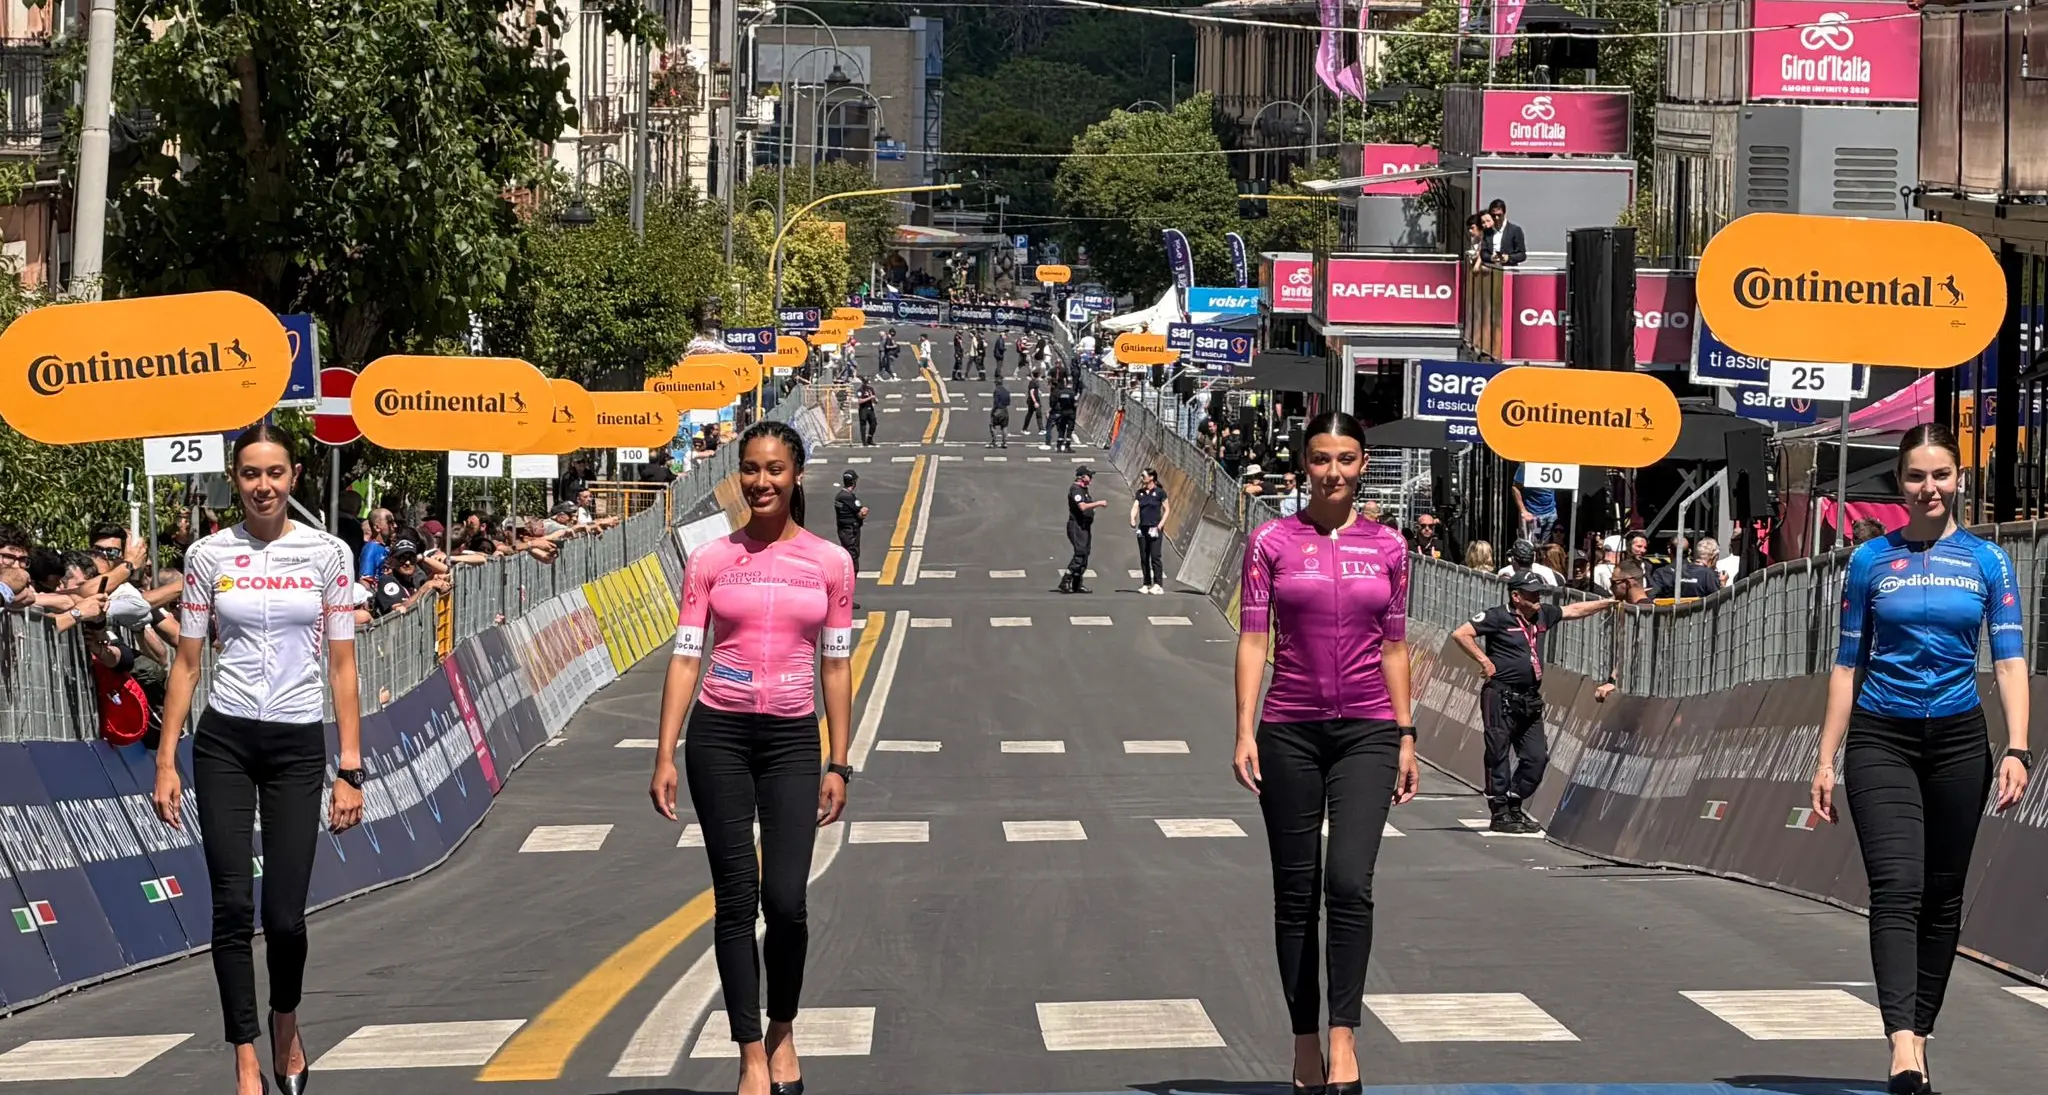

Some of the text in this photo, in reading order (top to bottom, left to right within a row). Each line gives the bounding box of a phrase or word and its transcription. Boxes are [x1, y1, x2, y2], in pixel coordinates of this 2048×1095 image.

[1781, 54, 1871, 82] Giro d'Italia
[1510, 121, 1532, 139] Giro
[1016, 236, 1026, 248] P
[1332, 283, 1452, 299] RAFFAELLO
[1733, 266, 1934, 310] Continental
[1208, 295, 1250, 308] valsir
[780, 311, 804, 321] sara
[727, 332, 756, 344] sara
[1171, 327, 1194, 339] sar
[1195, 336, 1229, 350] sara
[1709, 351, 1722, 367] ti
[28, 342, 222, 396] Continental
[653, 380, 716, 394] Continental
[1427, 372, 1487, 396] sara
[1791, 367, 1825, 391] 25
[374, 388, 506, 417] Continental
[1426, 398, 1436, 409] ti
[1743, 390, 1787, 408] sara
[1500, 398, 1632, 429] Continental
[1448, 424, 1478, 436] sara
[170, 440, 203, 463] 25
[621, 450, 643, 460] 100
[466, 453, 490, 469] 50
[1540, 467, 1563, 484] 50
[1341, 561, 1376, 576] ITA
[235, 576, 314, 590] CONAD
[1878, 573, 1980, 593] mediolanum
